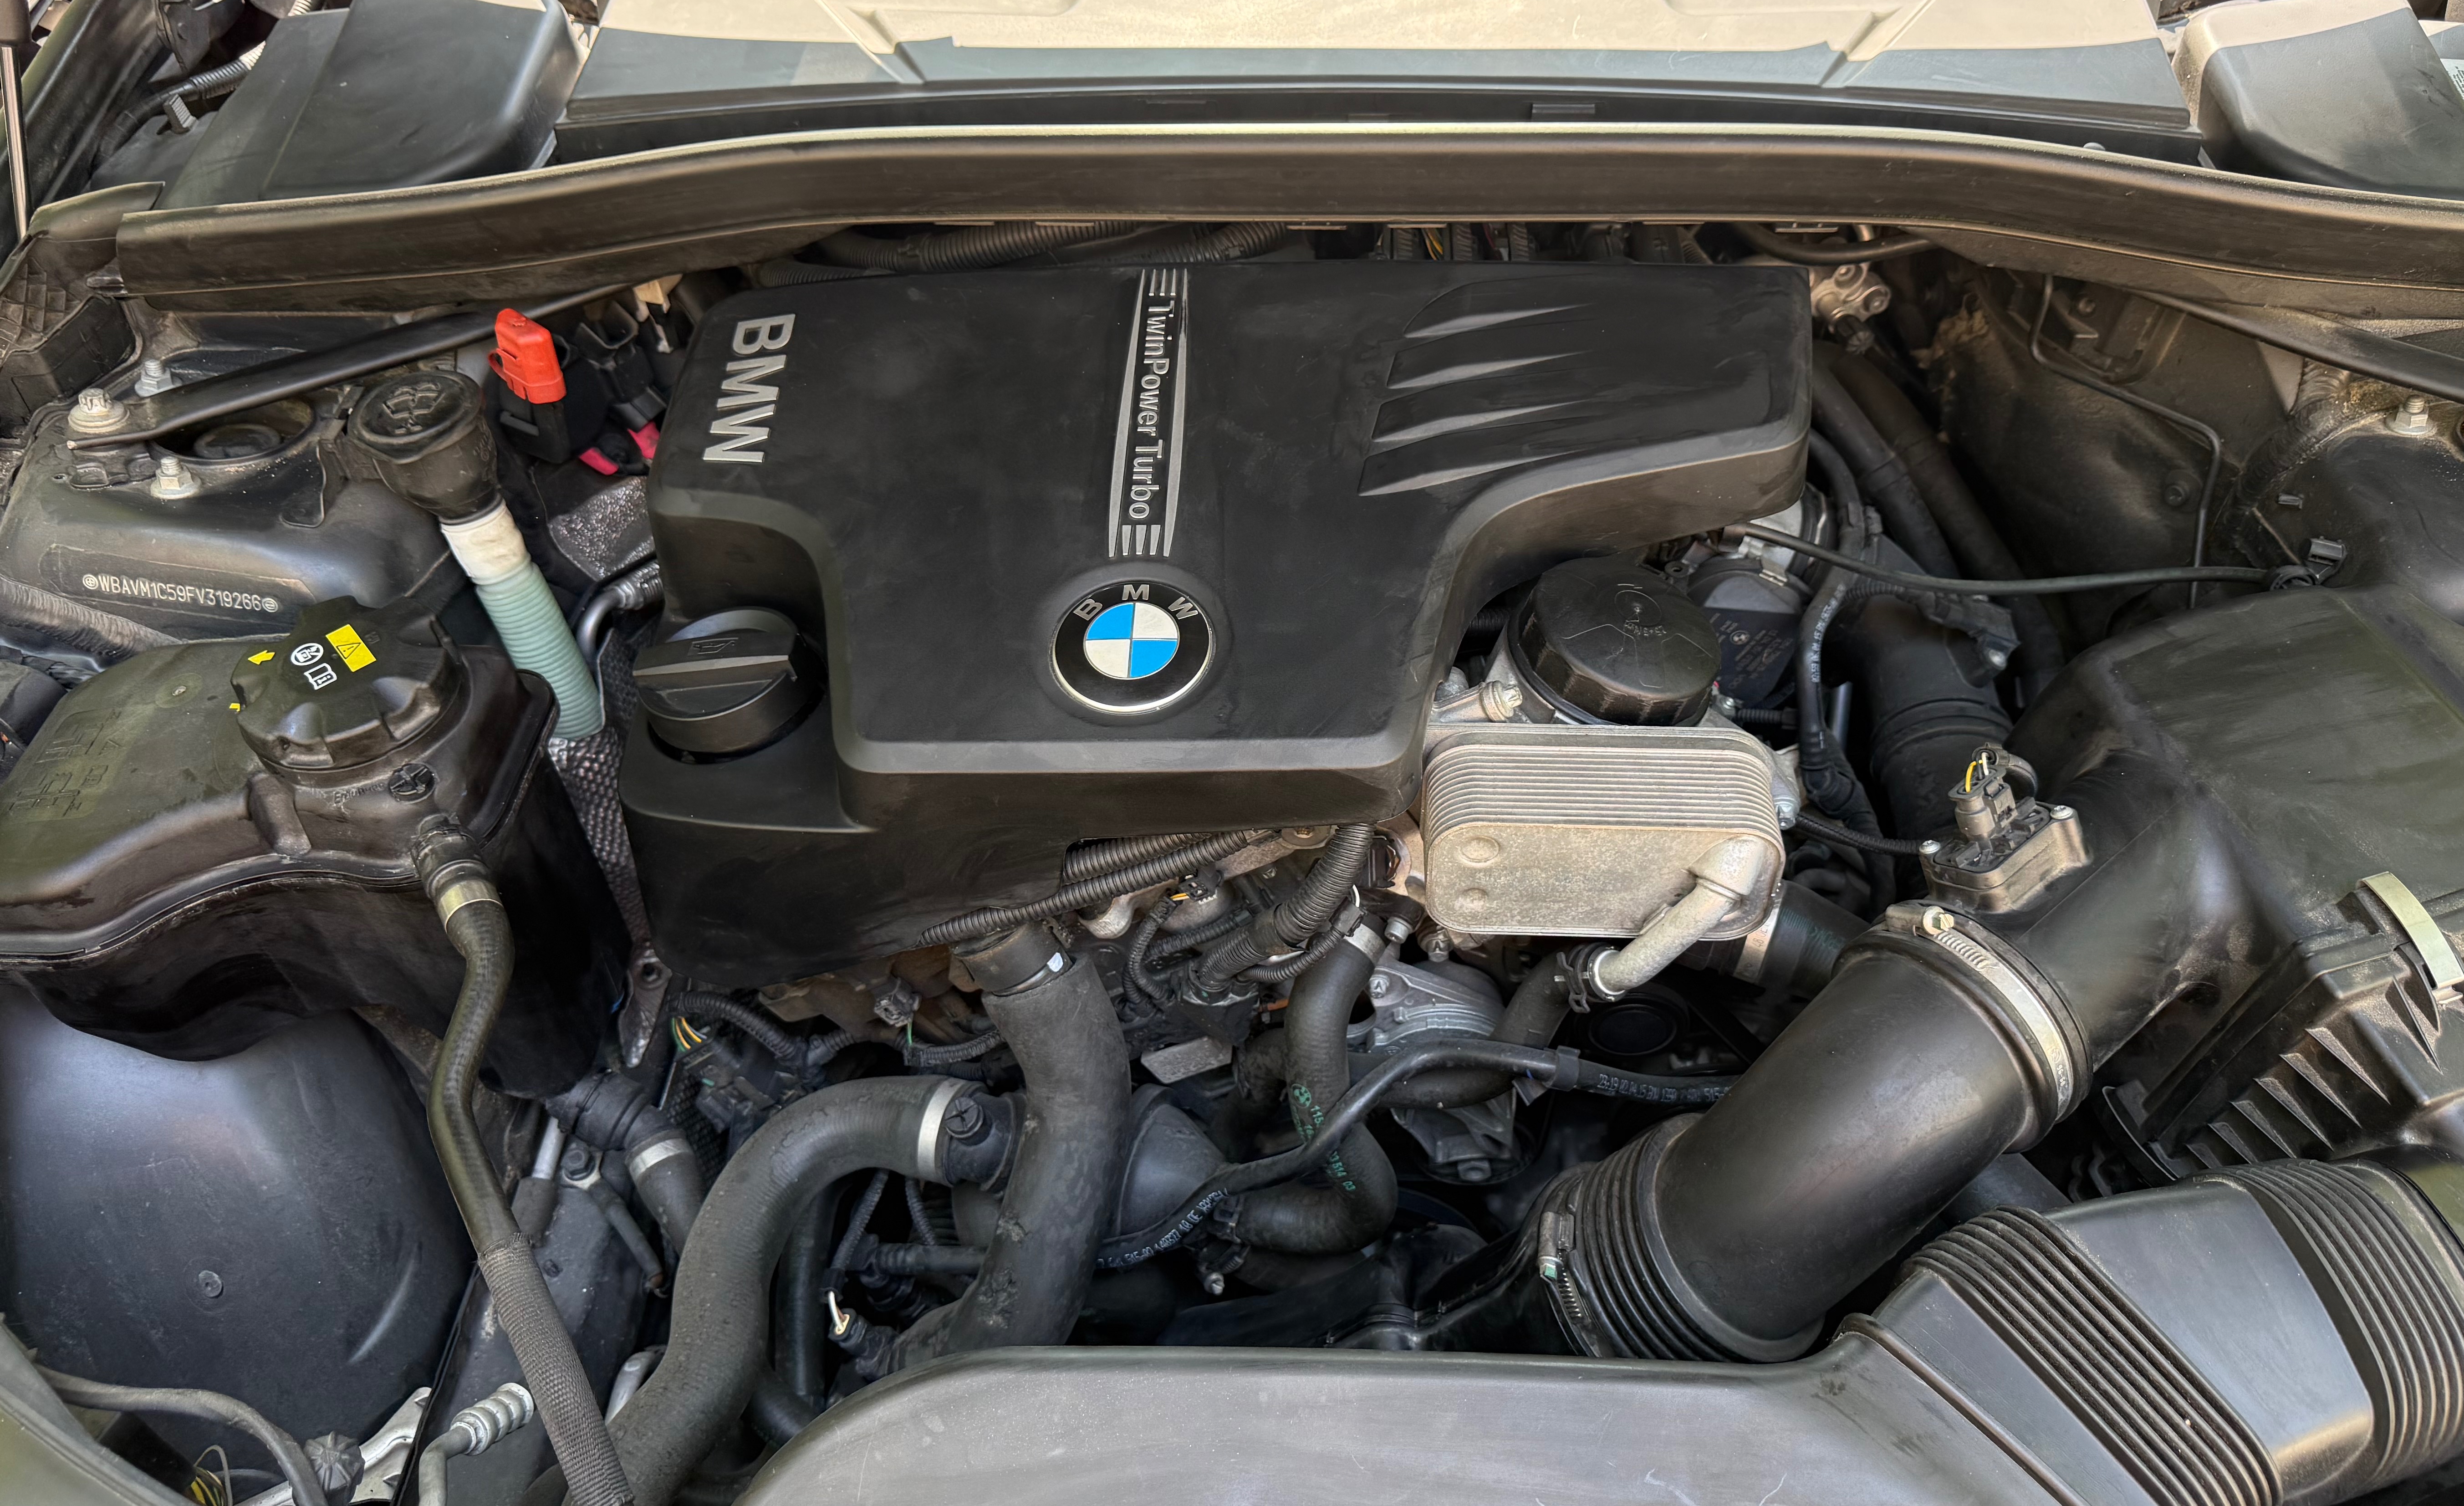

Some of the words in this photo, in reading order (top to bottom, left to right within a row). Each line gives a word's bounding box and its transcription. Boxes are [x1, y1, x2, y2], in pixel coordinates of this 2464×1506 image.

[703, 314, 796, 462] BMW
[1137, 300, 1175, 436] TwinPower
[1129, 439, 1163, 519] Turbo
[97, 575, 262, 612] WBAVM1C59FV319266
[1073, 584, 1199, 621] BMW
